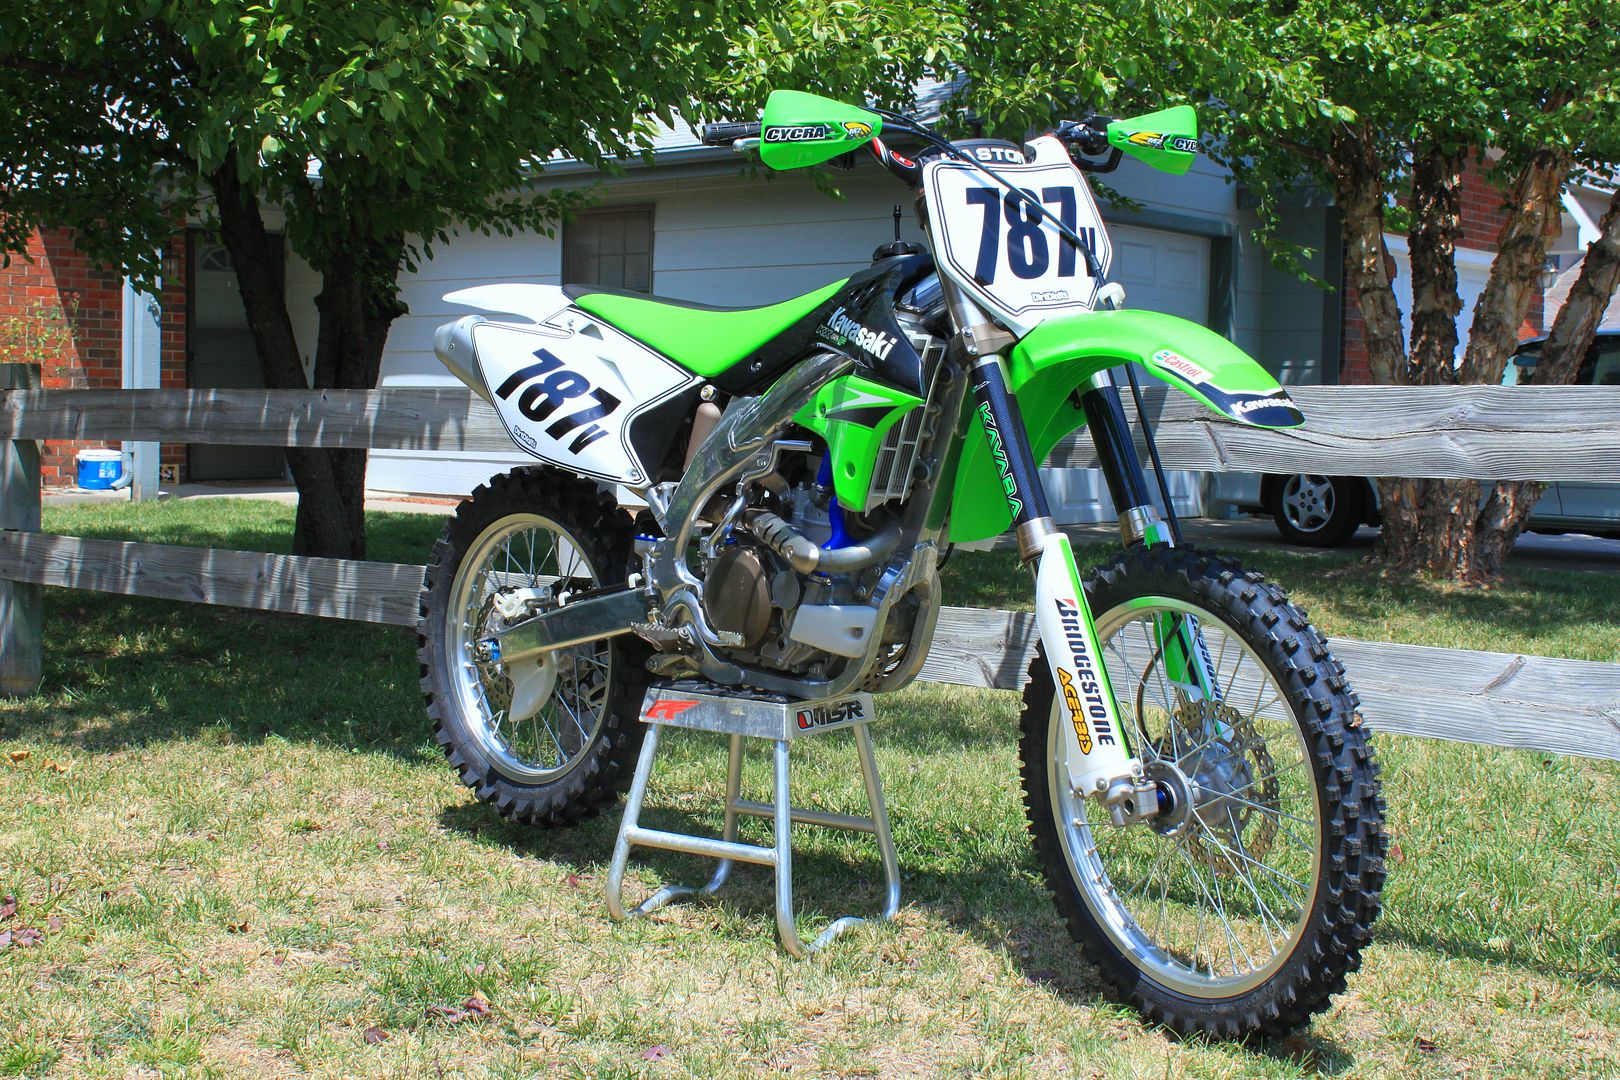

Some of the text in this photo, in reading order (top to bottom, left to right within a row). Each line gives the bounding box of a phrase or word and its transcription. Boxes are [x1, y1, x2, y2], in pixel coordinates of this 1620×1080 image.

[766, 127, 826, 141] CYCRA
[965, 186, 1077, 287] 787
[827, 306, 898, 361] Kawasaki
[1164, 355, 1203, 378] Castrol
[495, 347, 622, 441] 787
[1055, 598, 1116, 746] BRIDGESTONE
[1056, 667, 1094, 756] ACERBIS
